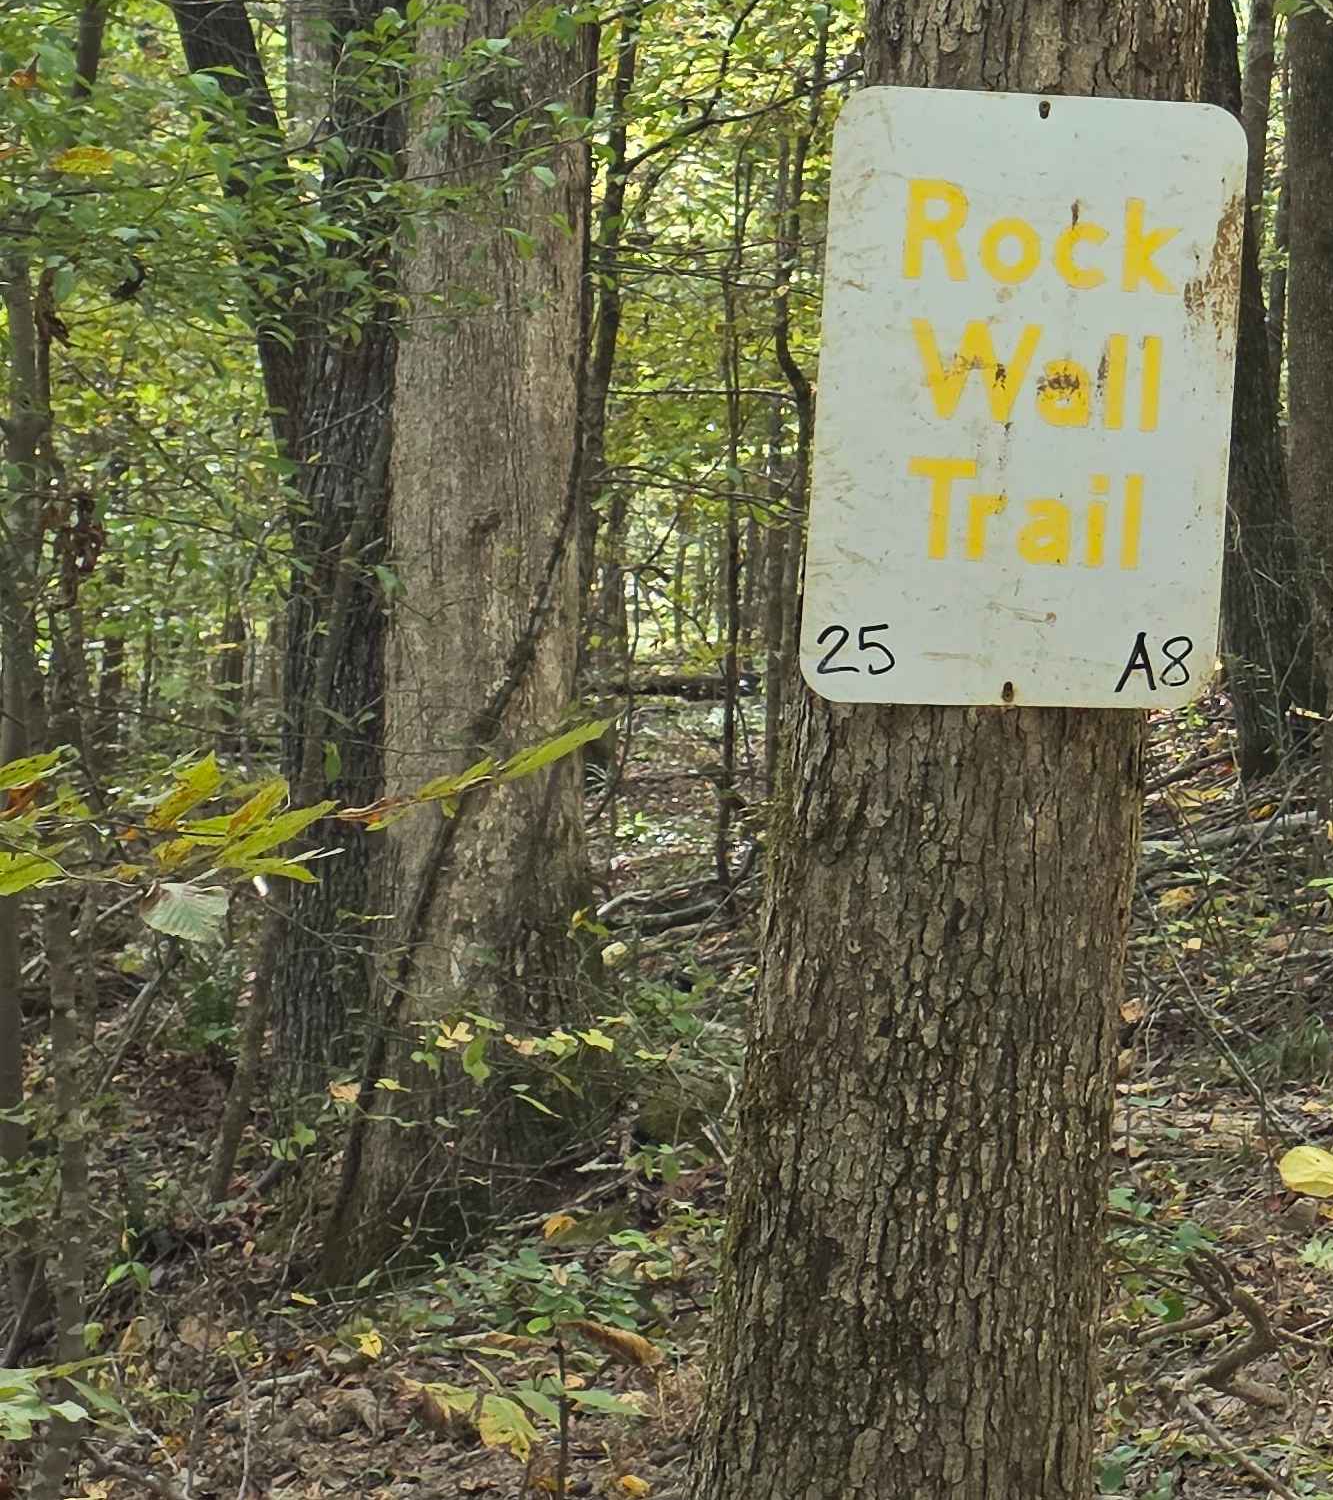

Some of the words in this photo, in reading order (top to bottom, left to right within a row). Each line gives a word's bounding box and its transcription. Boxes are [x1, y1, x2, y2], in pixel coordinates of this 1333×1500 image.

[902, 178, 1179, 294] Rock
[911, 318, 1163, 431] Wall
[907, 457, 1145, 570] Trail
[816, 625, 895, 676] 25
[1114, 632, 1193, 693] A8
